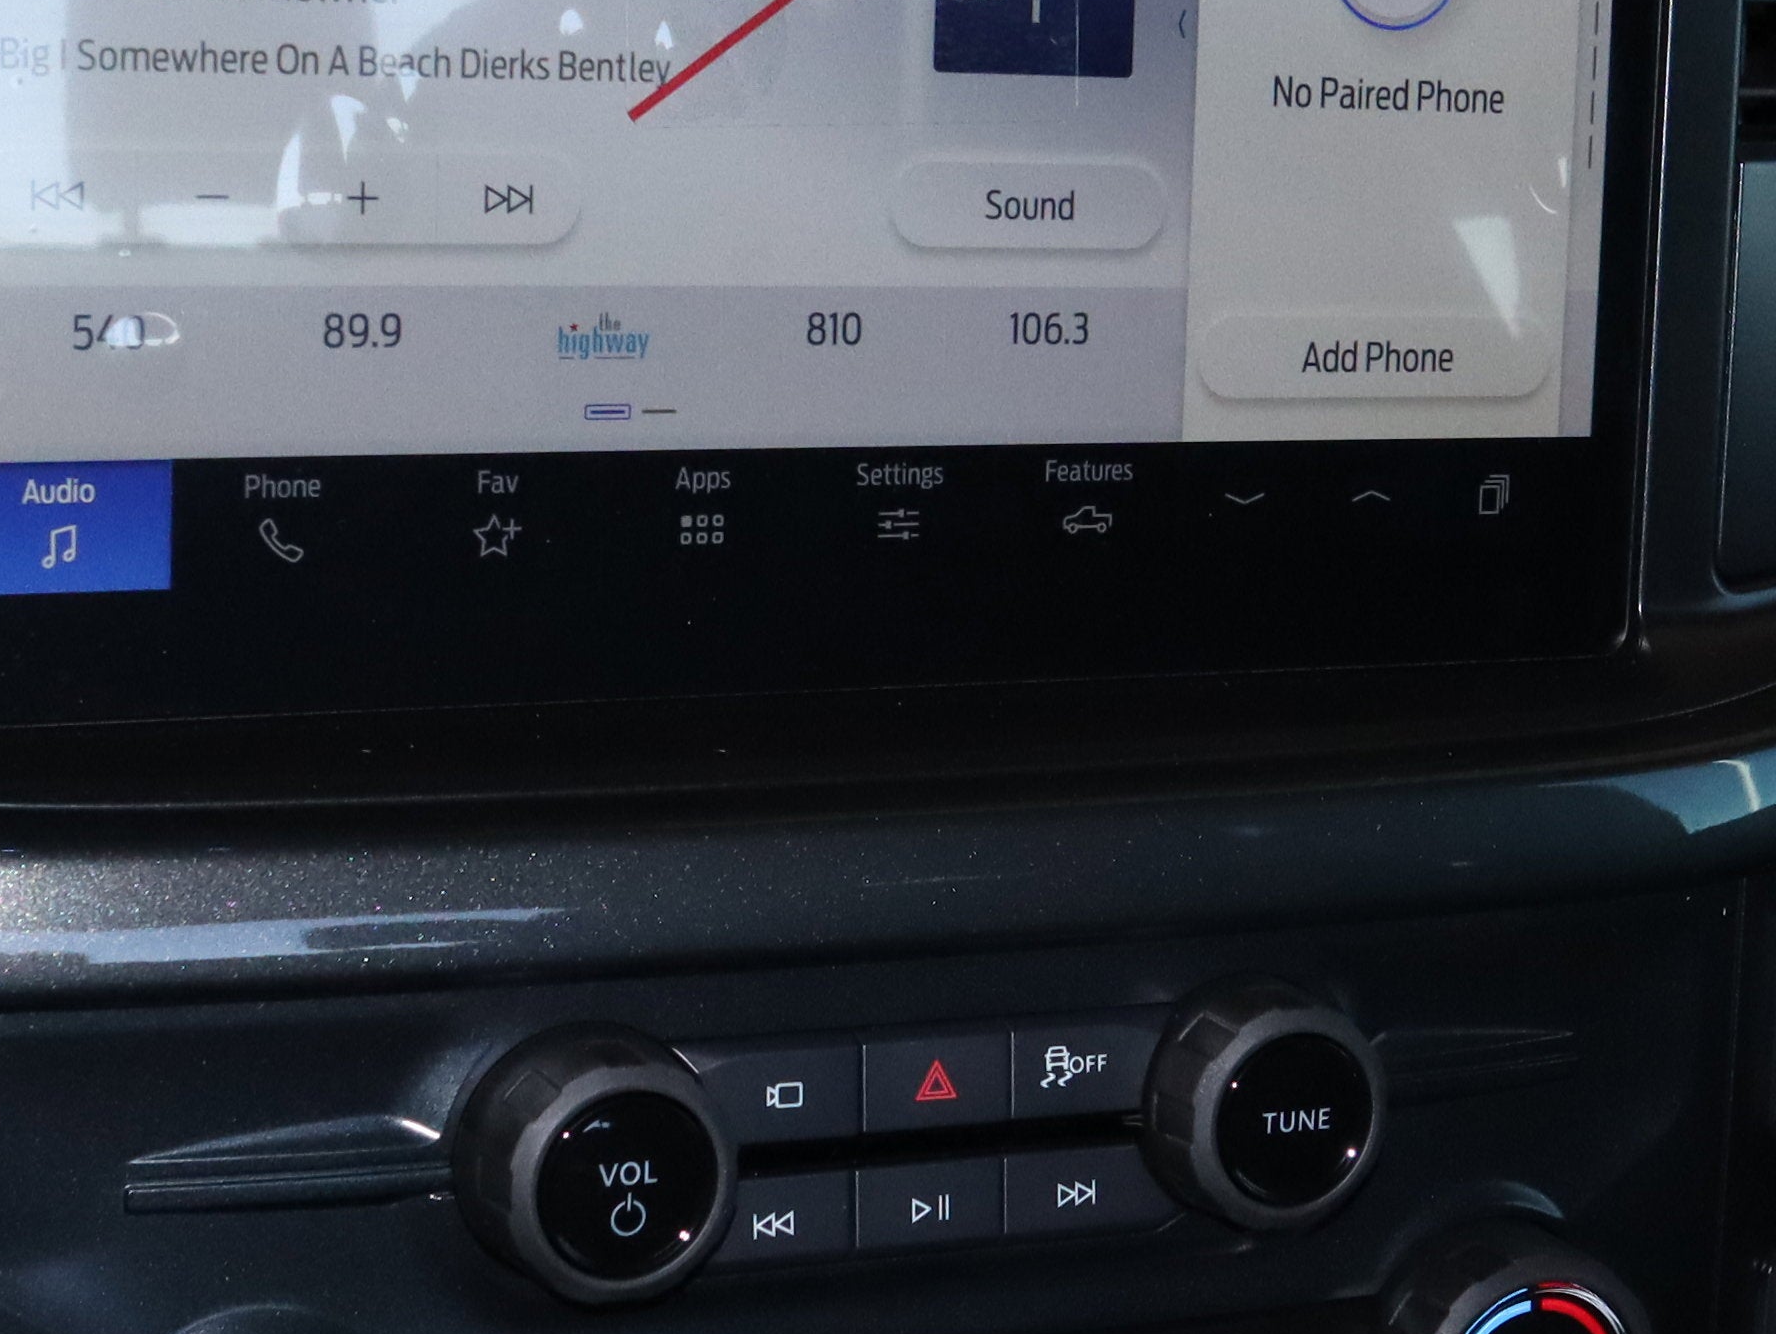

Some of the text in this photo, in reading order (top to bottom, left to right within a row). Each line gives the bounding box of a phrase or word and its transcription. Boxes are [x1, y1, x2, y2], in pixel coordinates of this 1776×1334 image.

[0, 36, 50, 77] Big
[76, 38, 268, 76] Somewhere
[276, 42, 320, 76] On
[328, 44, 350, 78] A
[358, 45, 451, 79] Beach
[460, 48, 550, 80] Dierks
[558, 50, 671, 88] Bentley
[1272, 75, 1505, 116] No Paired Phone
[984, 187, 1075, 223] Sound
[323, 312, 403, 349] 89.9
[598, 312, 622, 332] the
[806, 311, 863, 348] 810
[1010, 311, 1090, 347] 106.3
[557, 326, 651, 360] highway
[1301, 340, 1455, 376] Add Phone
[244, 472, 321, 500] Phone
[477, 469, 519, 496] Fav
[675, 466, 732, 494] Apps
[855, 461, 945, 491] Settings
[1044, 457, 1134, 486] Features
[21, 478, 96, 506] Audio
[1069, 1051, 1108, 1075] OFF
[1261, 1106, 1331, 1135] TUNE
[598, 1161, 658, 1187] VOL
